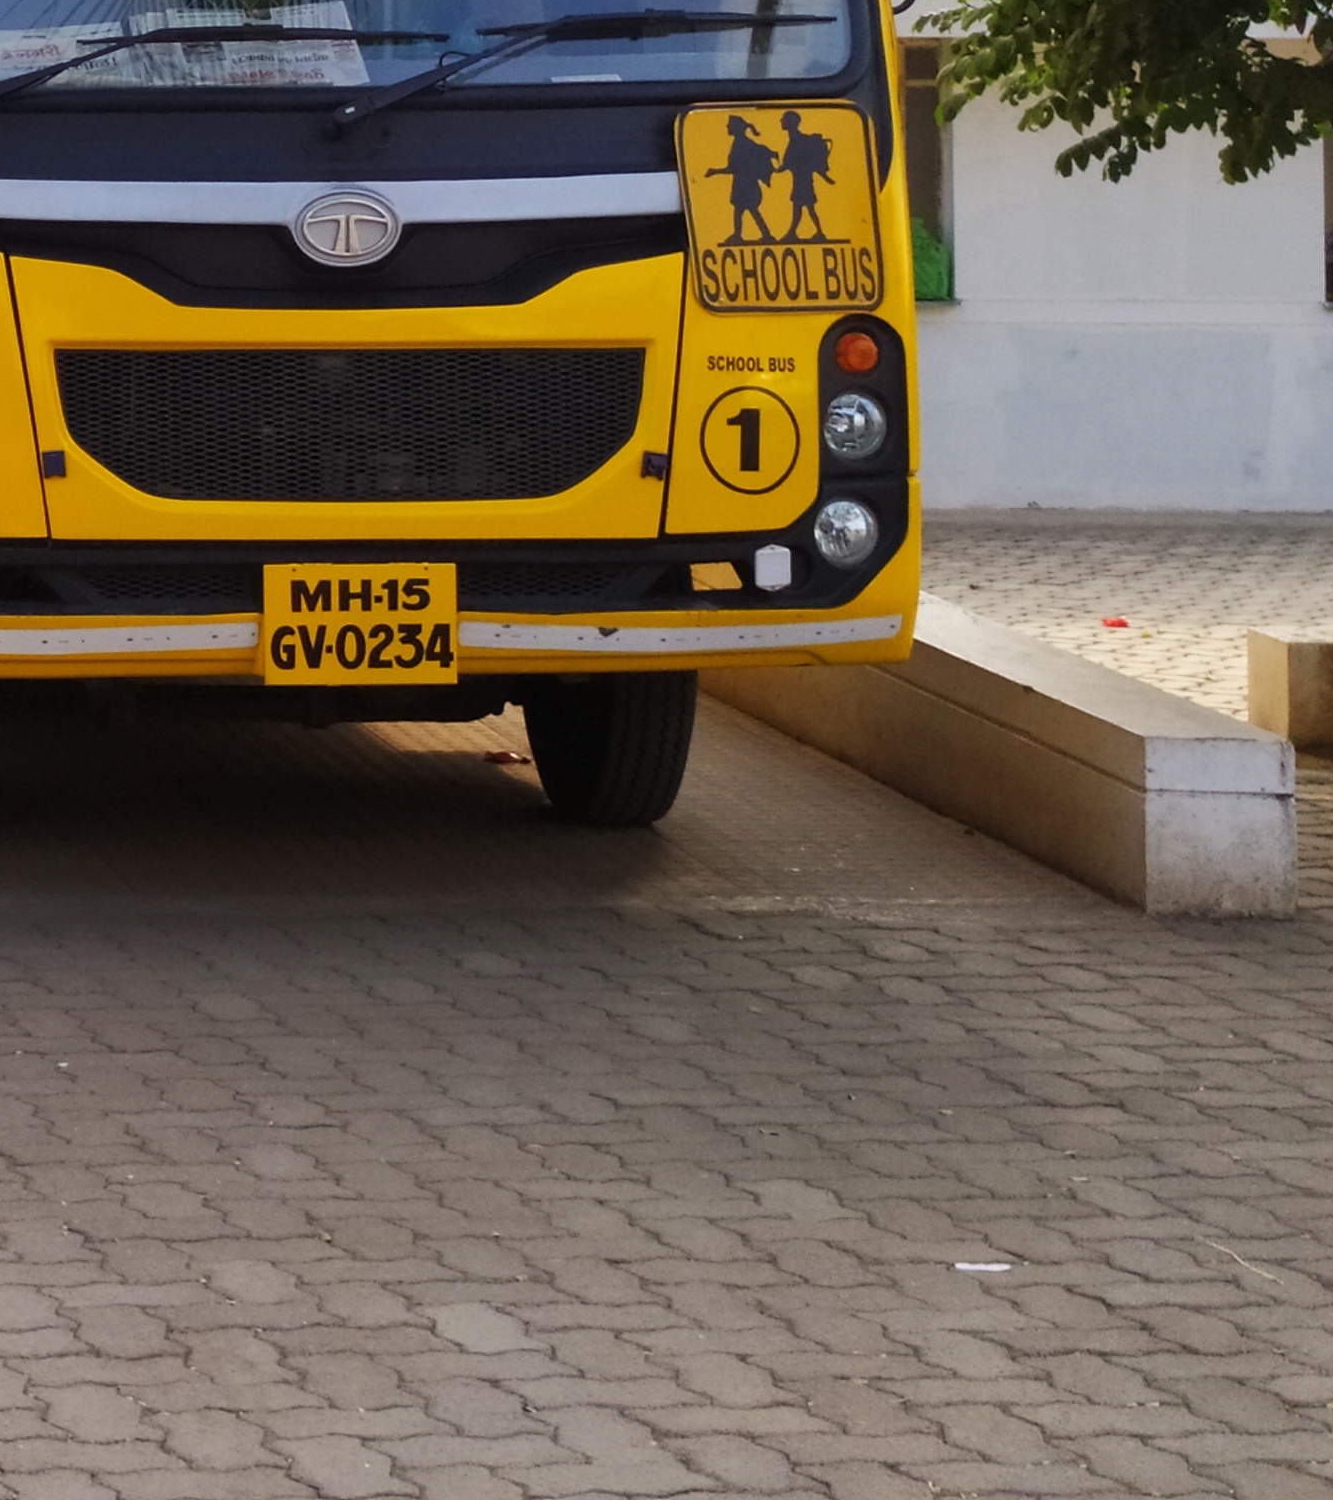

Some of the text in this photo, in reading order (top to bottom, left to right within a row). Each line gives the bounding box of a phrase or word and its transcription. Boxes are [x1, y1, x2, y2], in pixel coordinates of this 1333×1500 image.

[702, 247, 876, 302] SCHOOL BUS
[707, 355, 795, 372] SCHOOL BUS
[726, 408, 761, 472] 1
[290, 577, 431, 613] MH-15
[270, 623, 454, 670] GV-0234
